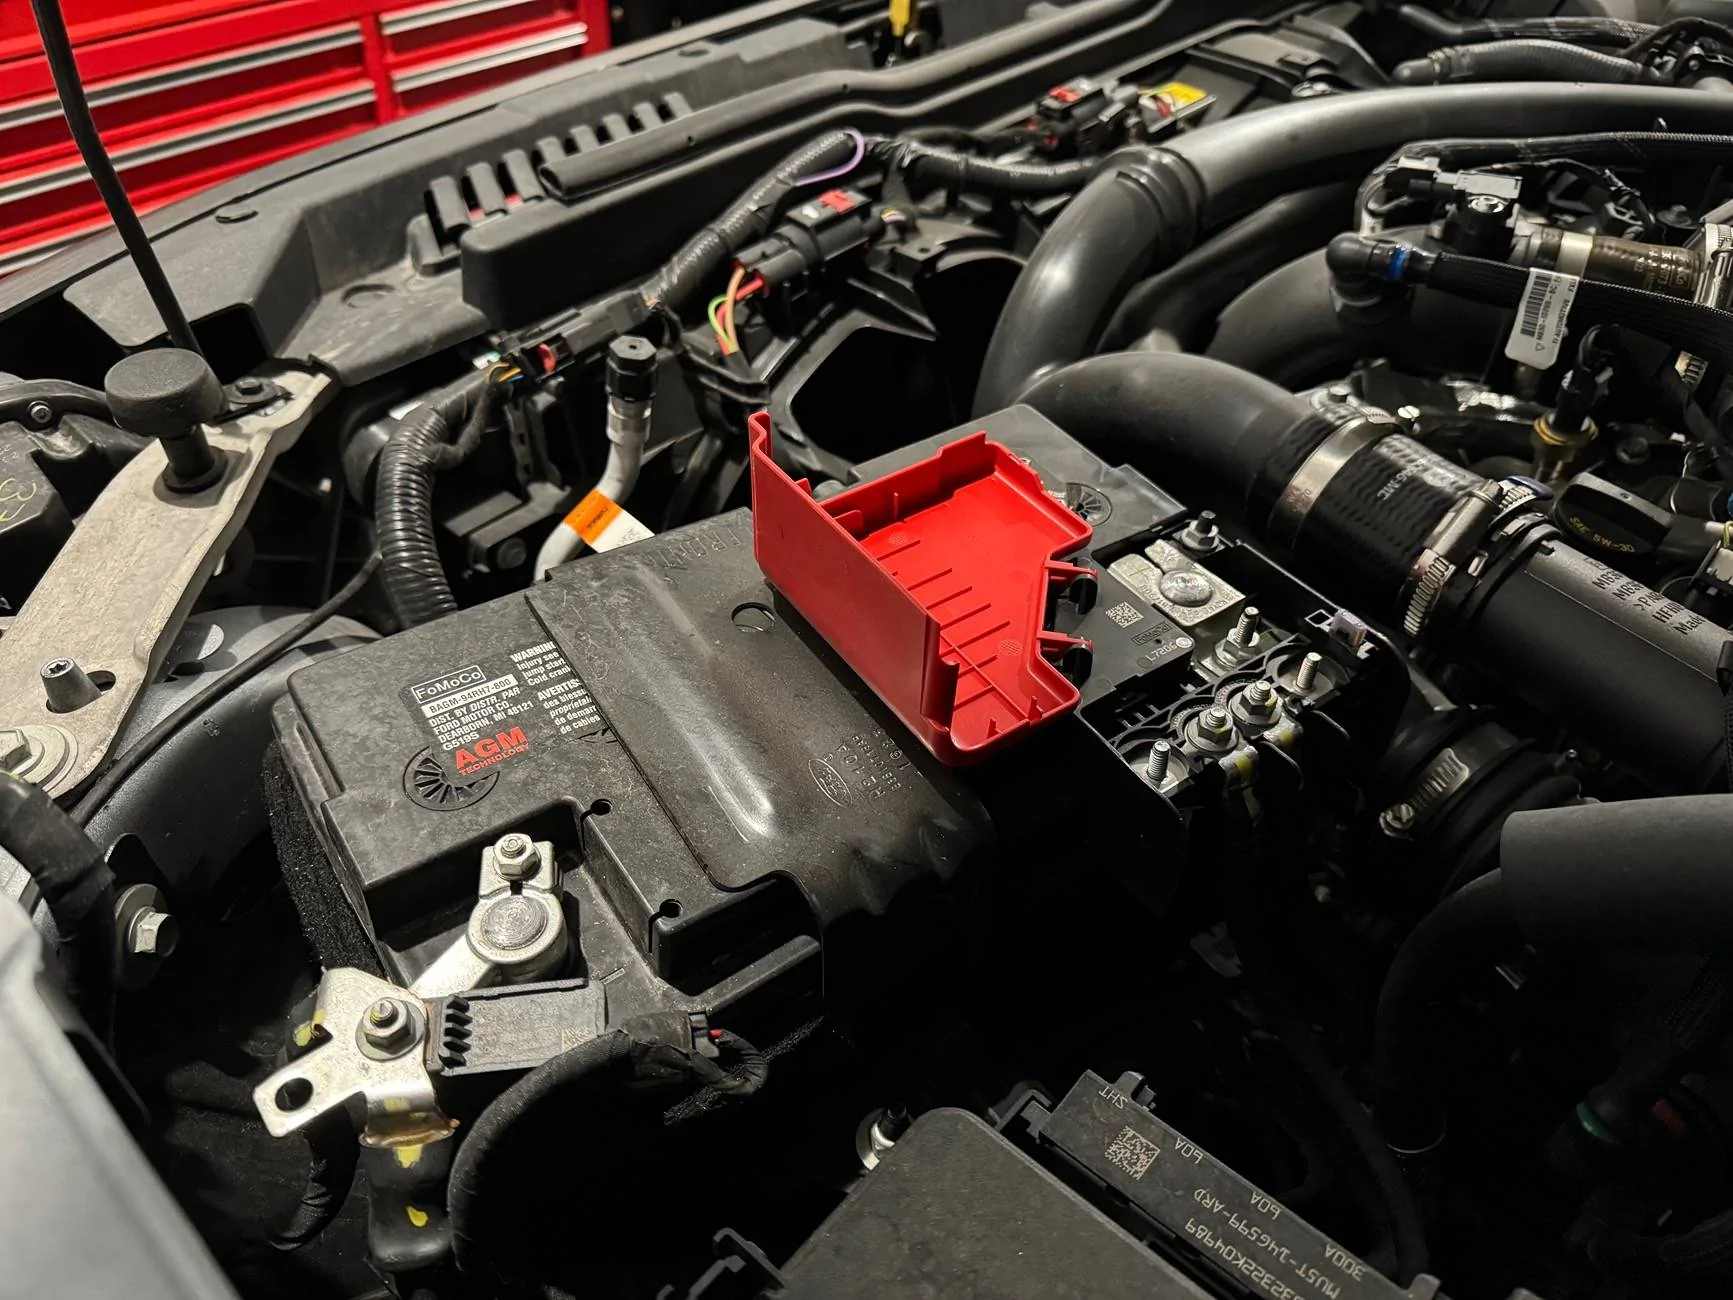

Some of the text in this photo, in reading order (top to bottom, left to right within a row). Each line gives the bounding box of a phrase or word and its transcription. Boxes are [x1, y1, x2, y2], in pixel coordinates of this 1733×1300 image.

[1592, 535, 1636, 553] 5W-30
[516, 656, 543, 672] Injury
[416, 669, 482, 700] FoMoCo
[527, 672, 549, 687] Cold
[428, 687, 521, 727] DIST. BY DISTR. PAR
[433, 701, 514, 735] FORD MOTOR CO.
[542, 698, 559, 709] des
[437, 701, 534, 744] DEARBORN, MI 48121
[554, 714, 566, 727] de
[559, 713, 600, 736] de cables
[442, 732, 480, 751] G519S
[455, 726, 528, 770] AGM
[458, 743, 530, 776] TECHNOLOGY
[1099, 1085, 1128, 1110] SHT
[1175, 1136, 1204, 1165] 60A
[1251, 1191, 1282, 1221] 60A
[1324, 1243, 1367, 1282] 300A
